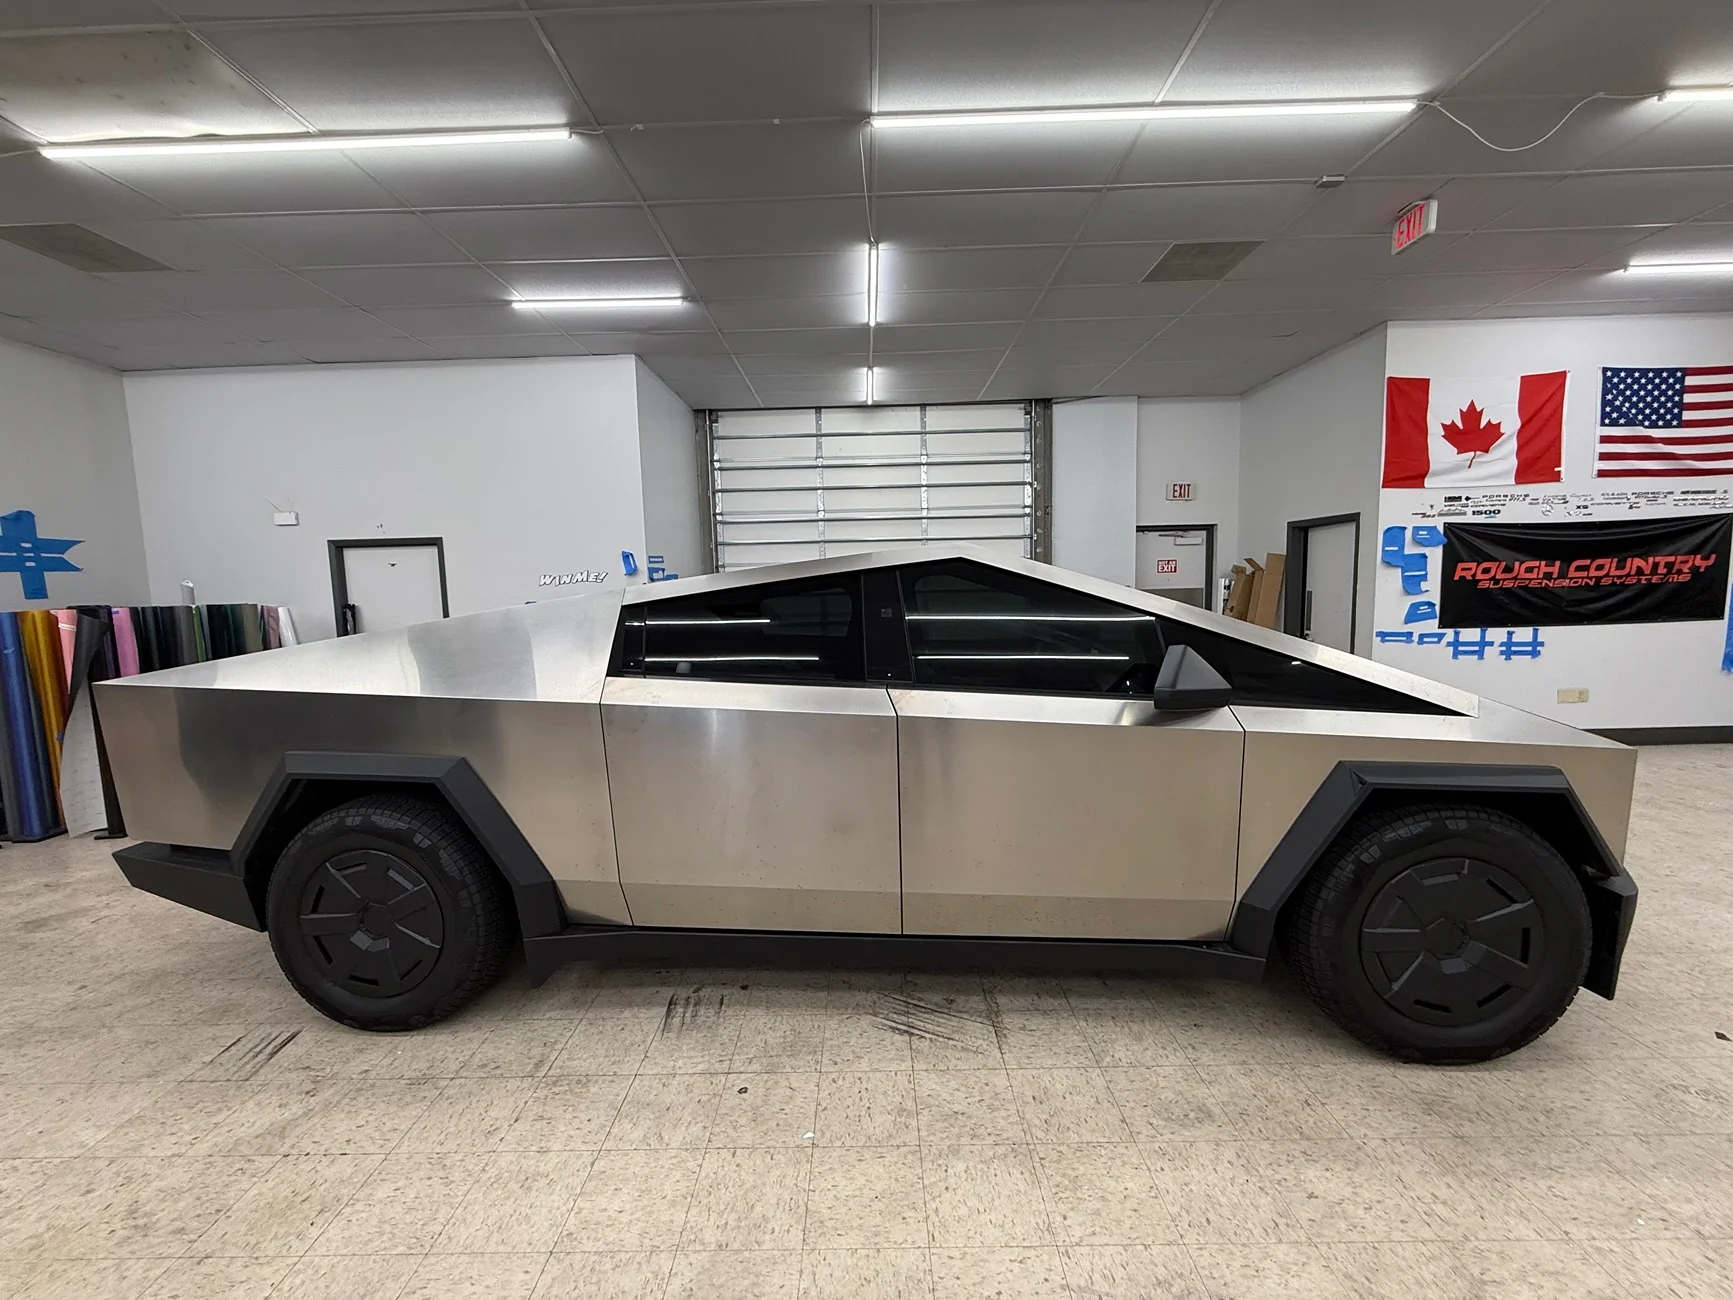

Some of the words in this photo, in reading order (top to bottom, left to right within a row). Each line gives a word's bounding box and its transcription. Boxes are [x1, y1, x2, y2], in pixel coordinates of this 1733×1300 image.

[1396, 203, 1426, 249] EXIT
[1172, 483, 1191, 498] EXIT
[1453, 561, 1560, 581] ROUGH
[1567, 553, 1717, 578] COUNTRY
[539, 573, 573, 587] WIN
[1477, 578, 1596, 588] SUSPENSION
[1600, 573, 1692, 585] SYSTEMS
